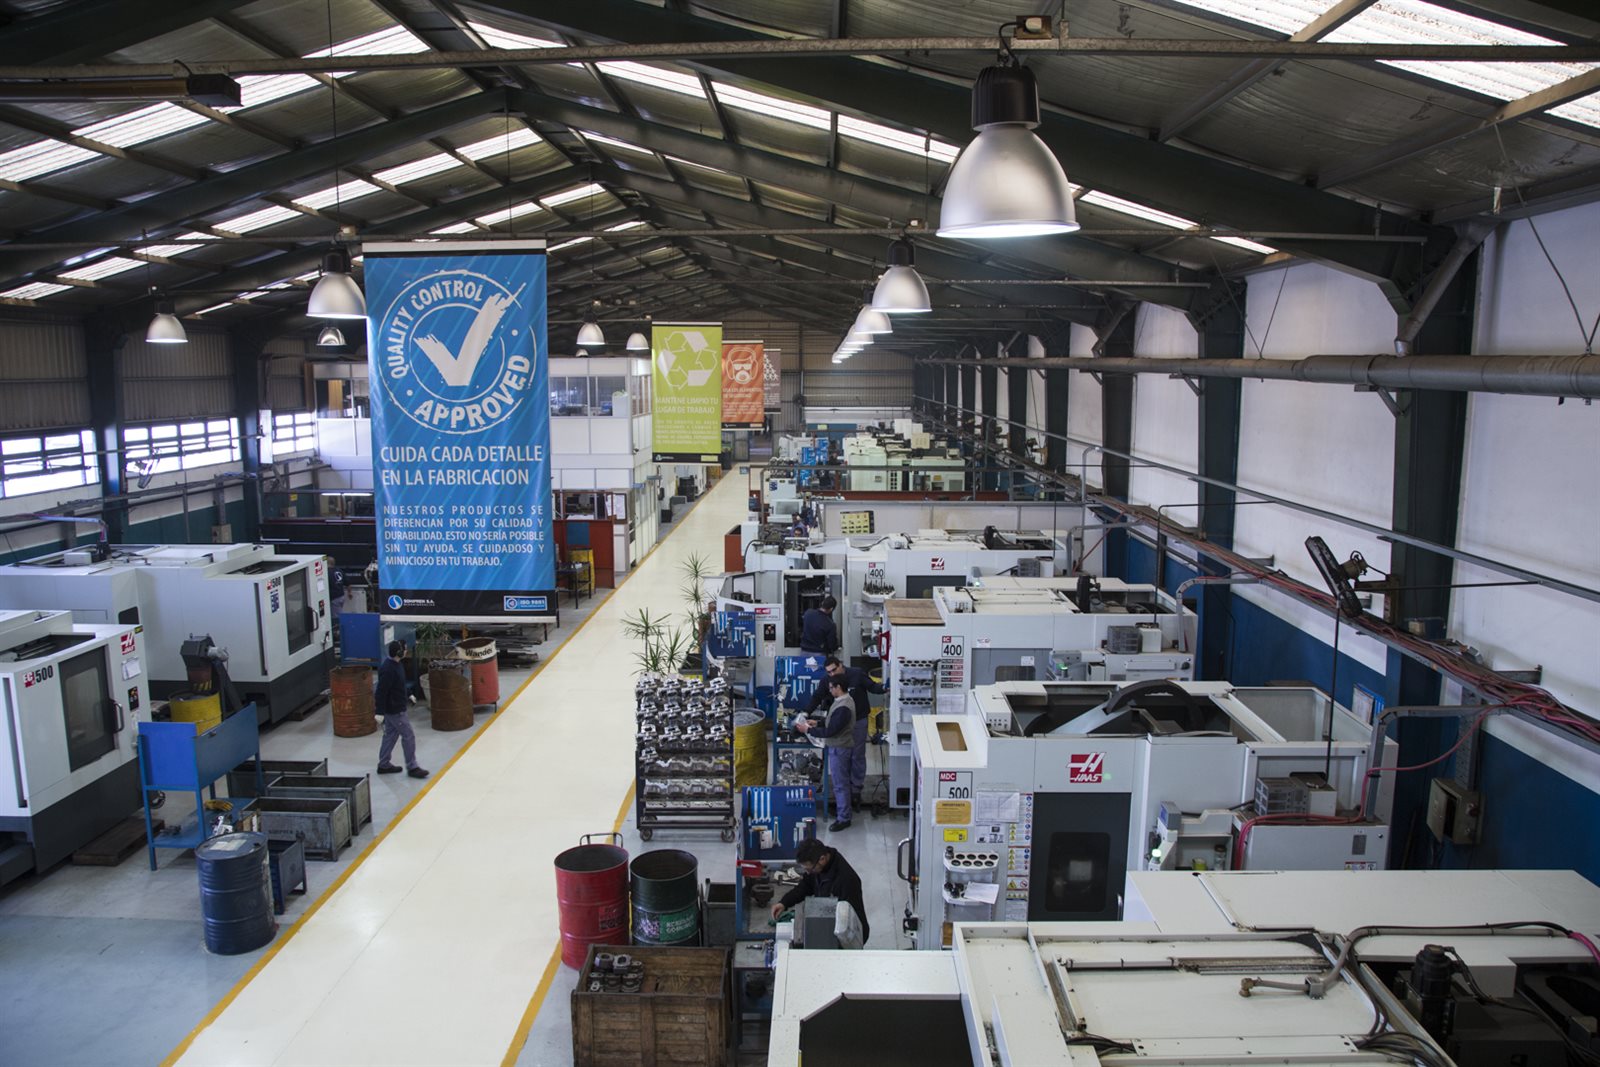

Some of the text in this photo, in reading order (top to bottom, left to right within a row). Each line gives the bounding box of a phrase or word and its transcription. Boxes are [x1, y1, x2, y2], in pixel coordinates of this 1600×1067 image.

[387, 280, 484, 379] QUALITY CONTROL
[415, 355, 530, 428] APPROVED
[711, 397, 719, 405] TU
[678, 406, 686, 414] DE
[687, 406, 715, 415] TRABAJO
[380, 445, 543, 463] CUIDA CADA DETALLE
[382, 469, 529, 486] EN LA FABRICACION
[384, 505, 543, 515] NUESTROS PRODUCTOS SE
[384, 518, 543, 528] DIFERENCIAN POR SU CALIDAD Y
[384, 529, 544, 541] DURABILIDAD. ESTO NO SERÍA POSIBLE
[385, 543, 544, 553] SIN TU AYUDA. SE CUIDADOSO Y
[385, 556, 502, 566] MINUCIOSO EN TU TRABAJO.
[869, 568, 884, 578] 400
[943, 644, 962, 656] 400
[36, 665, 53, 683] 500
[949, 787, 969, 799] 500
